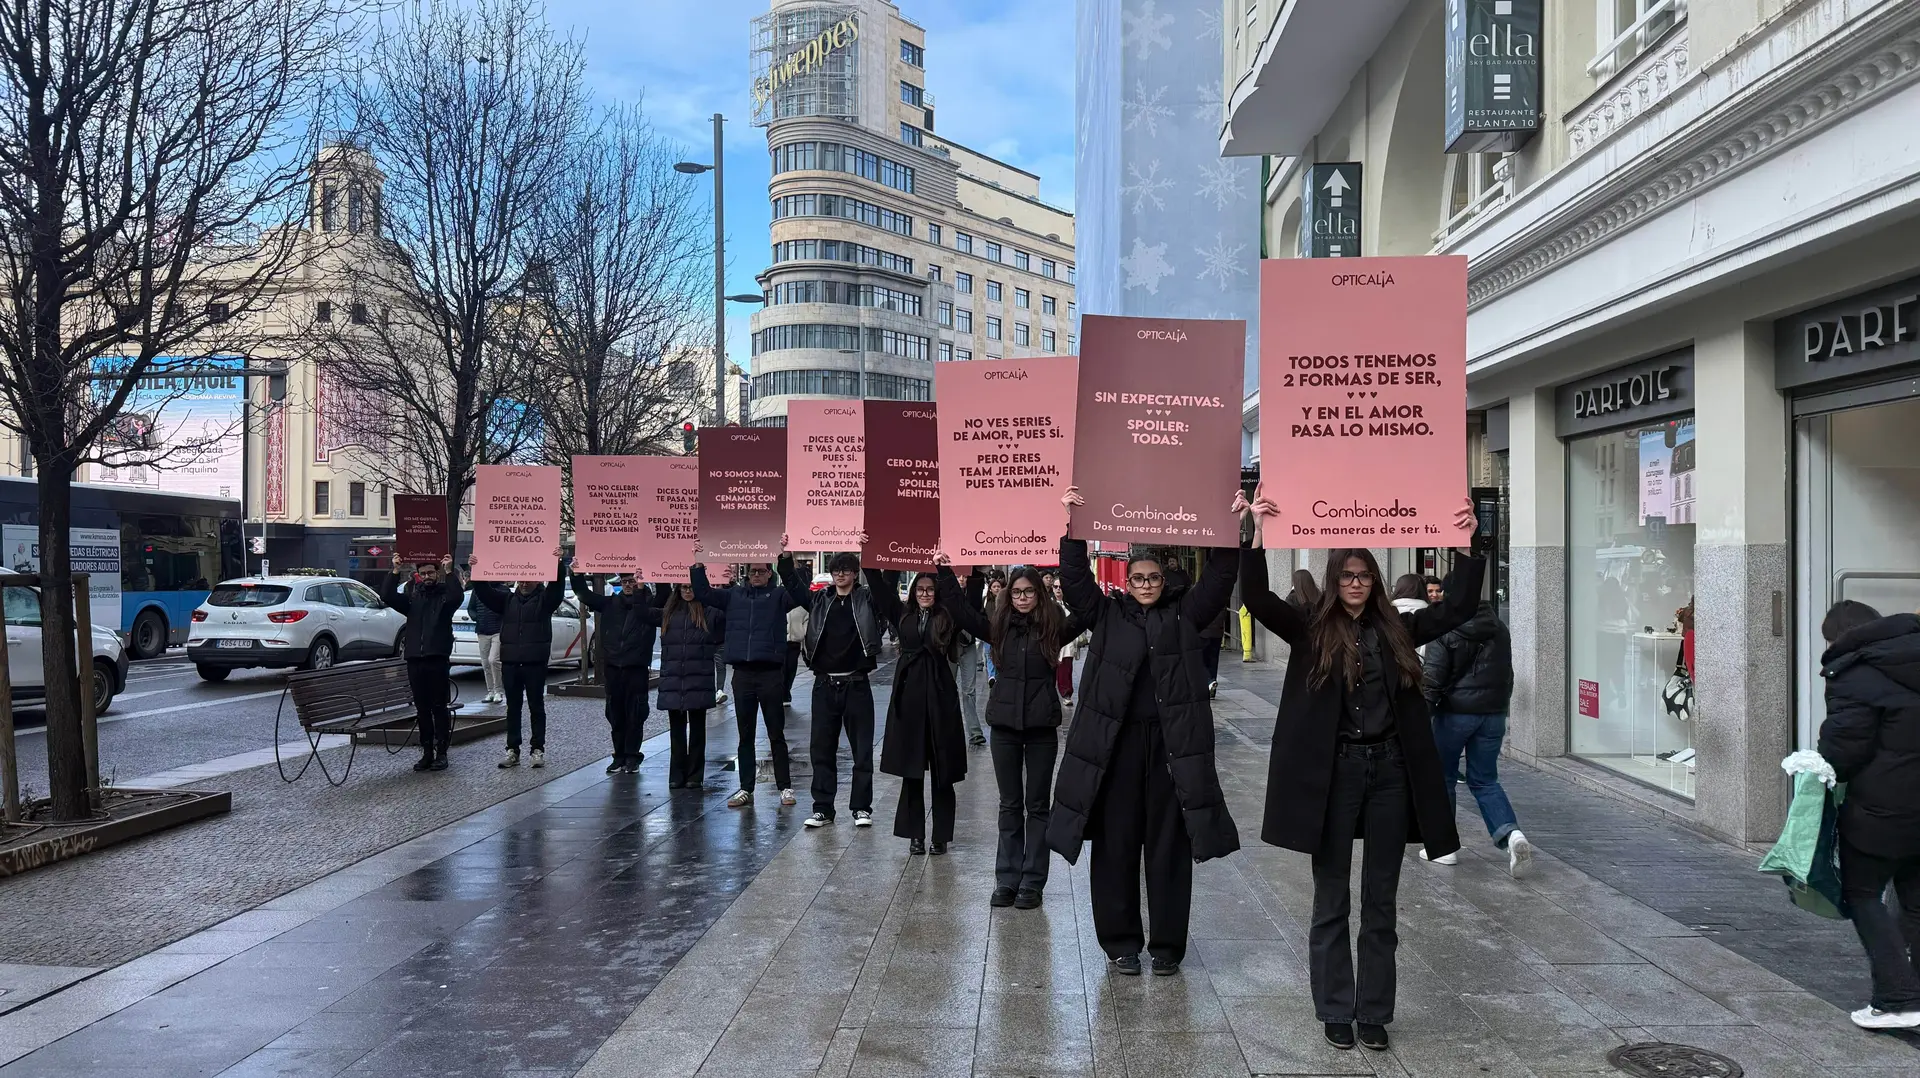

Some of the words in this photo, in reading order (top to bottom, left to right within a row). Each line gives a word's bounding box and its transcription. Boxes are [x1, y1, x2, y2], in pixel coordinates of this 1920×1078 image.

[1468, 119, 1516, 127] PLANTA
[1522, 119, 1534, 127] 10
[1289, 356, 1349, 369] TODOS
[1354, 354, 1436, 368] TENEMOS
[1284, 374, 1294, 387] 2
[1300, 373, 1372, 386] FORMAS
[1378, 372, 1399, 385] DE
[1405, 372, 1441, 387] SER,
[1574, 366, 1670, 419] PARFOIS
[1095, 392, 1117, 402] SIN
[1121, 393, 1224, 407] EXPECTATIVAS.
[1302, 407, 1312, 419] Y
[1318, 407, 1339, 419] EN
[1345, 406, 1363, 419] EL
[1369, 405, 1423, 418] AMOR
[965, 419, 983, 428] NO
[987, 418, 1009, 427] VES
[1013, 417, 1051, 427] SERIES
[1127, 419, 1188, 432] SPOILER:
[954, 432, 968, 441] DE
[972, 431, 1013, 441] AMOR,
[1017, 429, 1045, 439] PUES
[1050, 426, 1063, 438] SÍ.
[1292, 424, 1334, 437] PASA
[1341, 423, 1363, 436] LO
[1369, 423, 1433, 436] MISMO.
[837, 436, 855, 444] QUE
[1132, 433, 1182, 445] TODAS.
[846, 453, 857, 462] SÍ.
[887, 459, 912, 467] CERO
[978, 454, 1009, 464] PERO
[1013, 453, 1040, 463] ERES
[181, 466, 219, 475] inquilino
[959, 467, 991, 476] TEAM
[996, 465, 1059, 476] JEREMIAH,
[966, 479, 994, 488] PUES
[998, 476, 1053, 488] TAMBIÉN.
[1112, 504, 1197, 521] Combinados
[1312, 499, 1417, 518] Combinados
[1094, 521, 1112, 530] Dos
[1166, 525, 1178, 534] de
[1292, 525, 1315, 535] Dos
[1380, 523, 1395, 534] de
[1425, 524, 1440, 533] tú.
[975, 530, 1046, 543] Combinados
[720, 540, 768, 549] Combinados
[595, 553, 636, 561] Combinados
[961, 548, 976, 556] Dos
[1021, 547, 1031, 555] de
[493, 561, 536, 569] Combinados
